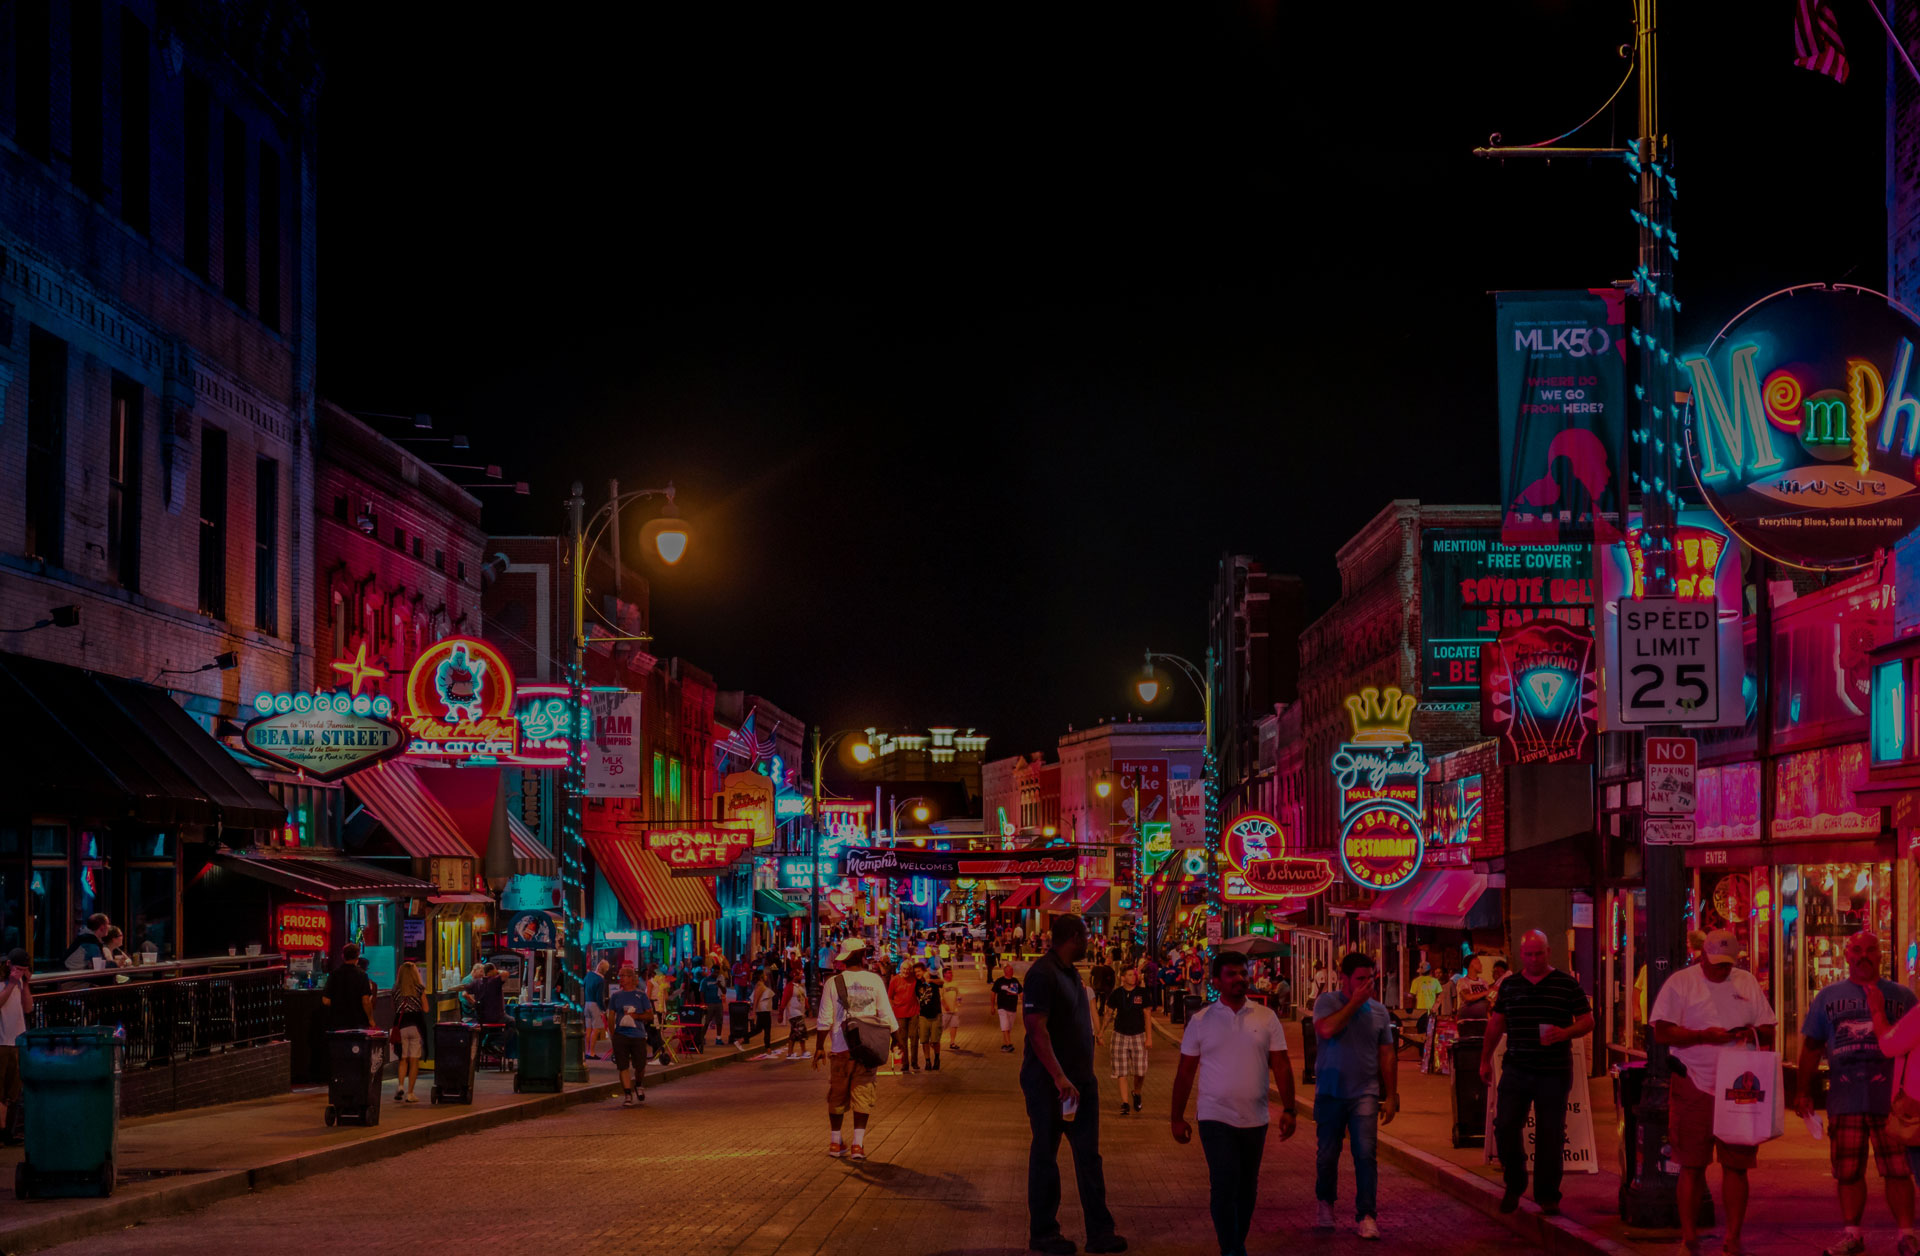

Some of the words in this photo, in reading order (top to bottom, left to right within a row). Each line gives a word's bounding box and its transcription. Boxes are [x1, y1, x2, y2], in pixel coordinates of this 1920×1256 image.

[1515, 327, 1610, 357] MLK50
[1528, 376, 1575, 387] WHERE
[1578, 376, 1598, 386] DO
[1541, 390, 1562, 400] WE
[1565, 389, 1585, 400] GO
[1521, 403, 1560, 414] FROM
[1563, 403, 1604, 414] HERE?
[1759, 518, 1801, 527] Everything
[1804, 518, 1829, 527] Blues,
[1830, 518, 1847, 526] Soul
[1849, 518, 1855, 526] &
[1433, 540, 1486, 552] MENTION
[1487, 554, 1522, 568] FREE
[1525, 553, 1572, 568] COVER
[1460, 576, 1544, 604] COYOTE
[1627, 612, 1709, 630] SPEED
[1434, 646, 1480, 659] LOCATE
[1637, 638, 1700, 656] LIMIT
[1630, 664, 1709, 709] 25
[596, 715, 602, 734] I
[606, 716, 632, 733] AM
[255, 729, 315, 746] BEALE
[321, 730, 391, 746] STREET
[596, 737, 632, 746] MEMPHIS
[445, 741, 475, 753] CITY
[1656, 743, 1686, 760] NO
[1152, 764, 1159, 772] a
[1650, 767, 1690, 777] PARKING
[1182, 796, 1200, 807] AM
[1348, 790, 1373, 799] HALL
[1374, 790, 1387, 799] OF
[1390, 790, 1417, 799] FAME
[1364, 810, 1400, 829] BAR
[1233, 820, 1277, 837] PIG
[694, 833, 748, 845] PALACE
[671, 848, 727, 862] CAFE
[1345, 838, 1417, 858] RESTAURANT
[1705, 851, 1728, 864] ENTER
[846, 854, 898, 877] Memphis
[899, 862, 954, 871] WELCOMES
[1005, 858, 1075, 872] AutoZone
[1267, 861, 1329, 881] Schwab
[1373, 860, 1414, 886] BEALE
[792, 876, 828, 887] HAL
[283, 914, 327, 929] FROZEN
[283, 932, 325, 947] DRINKS
[1563, 1149, 1589, 1161] Roll
